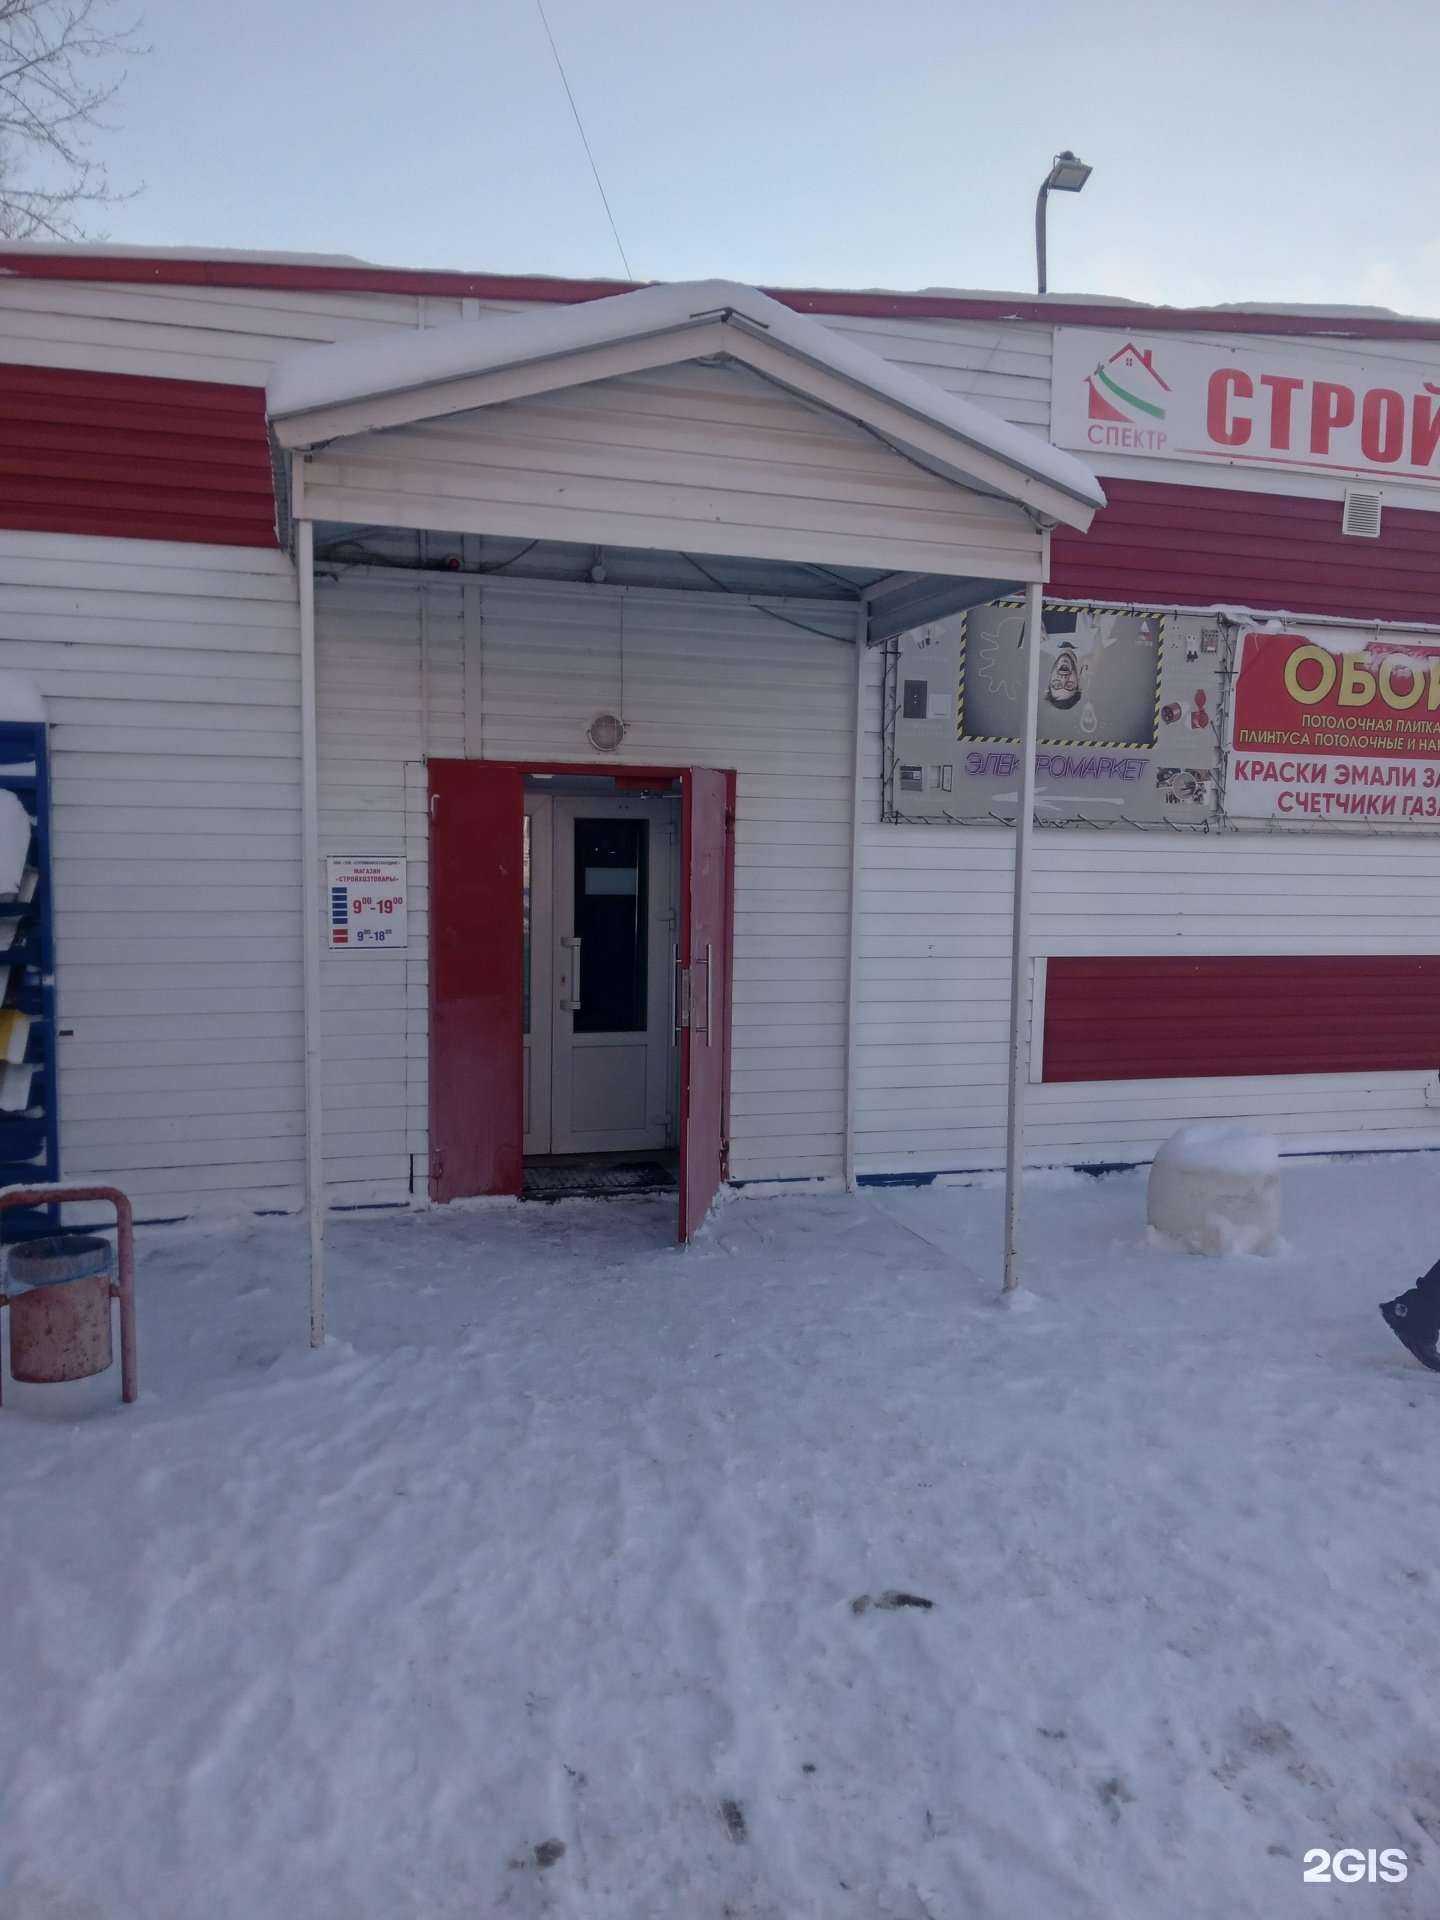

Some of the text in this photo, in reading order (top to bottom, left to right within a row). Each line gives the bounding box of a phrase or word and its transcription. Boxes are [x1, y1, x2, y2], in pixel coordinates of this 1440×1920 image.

[1087, 424, 1167, 450] СПЕКТР
[1302, 714, 1440, 734] ПОТОЛОЧНАЯ ПЛИТКА
[1239, 729, 1440, 752] ПЛИНТУСА ПОТОЛОЧНЫЕ И НА
[966, 752, 1149, 781] ЭЛЕКРОМАРКЕТ
[1234, 759, 1327, 784] КРАСКИ
[1334, 764, 1416, 787] ЭМАЛИ
[1277, 791, 1440, 817] СЧЕТЧИКИ ГАЗ
